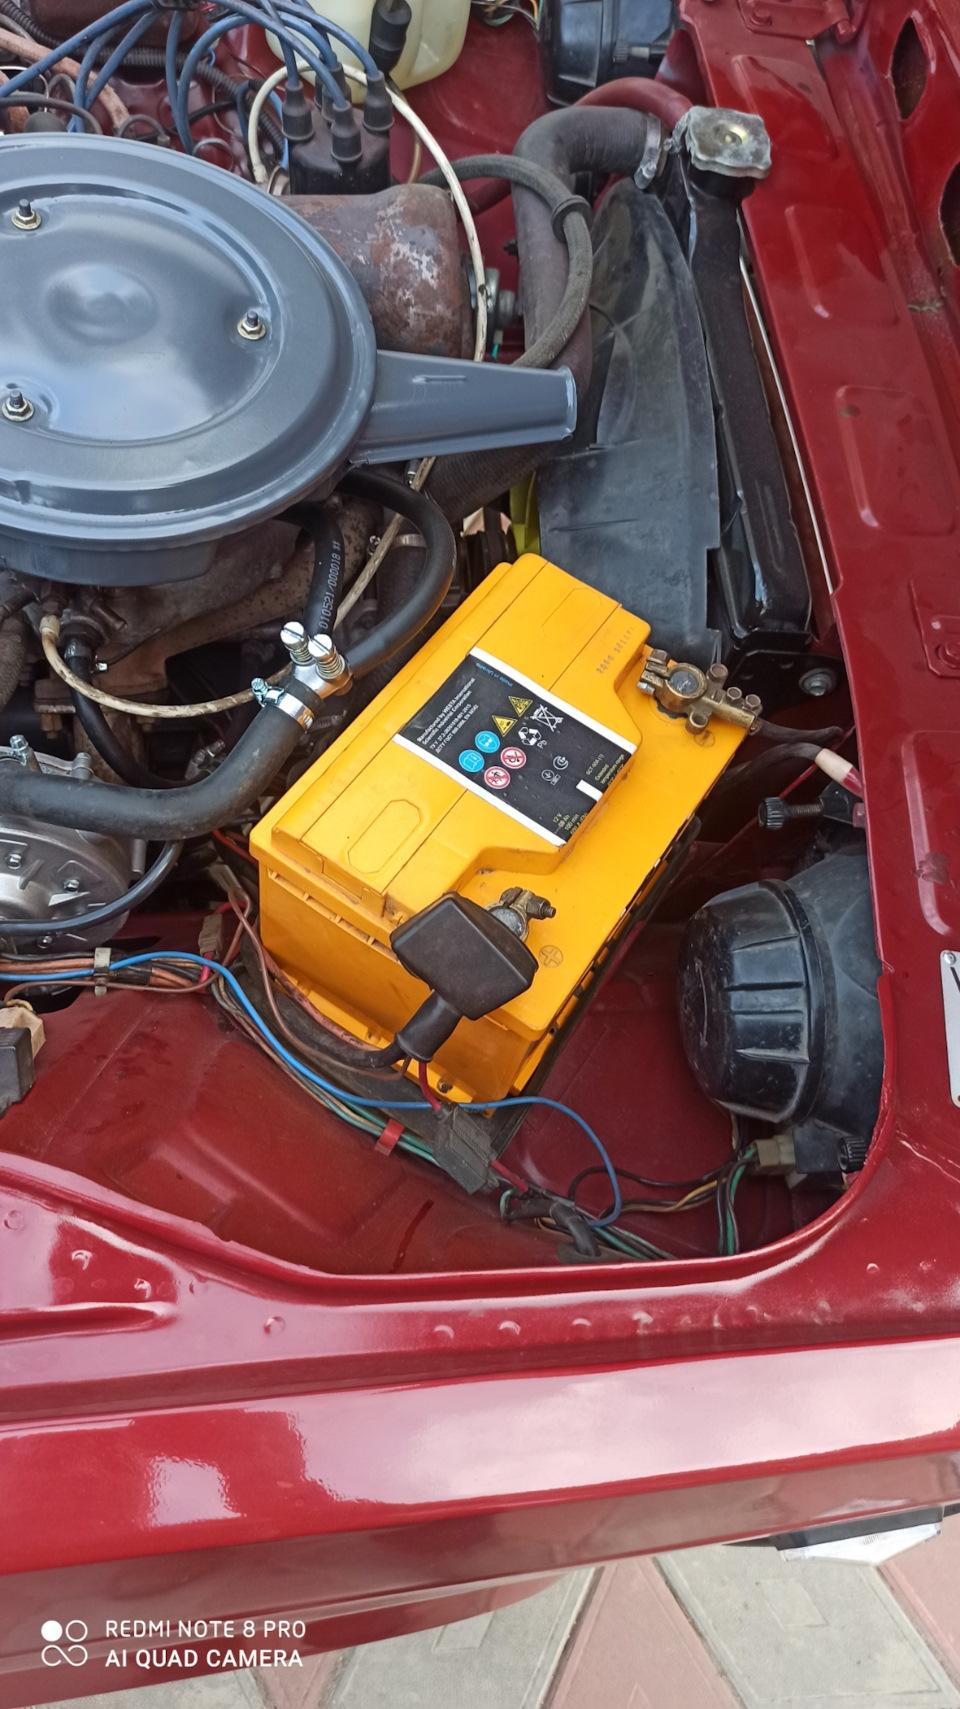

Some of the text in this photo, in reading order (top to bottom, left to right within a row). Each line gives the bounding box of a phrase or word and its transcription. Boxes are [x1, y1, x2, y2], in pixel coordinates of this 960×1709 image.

[319, 553, 340, 629] 010521/000018
[416, 717, 441, 742] Manufactured
[442, 699, 457, 714] WESTA
[454, 677, 475, 700] International
[421, 690, 472, 745] Scientific Industrial Corporation
